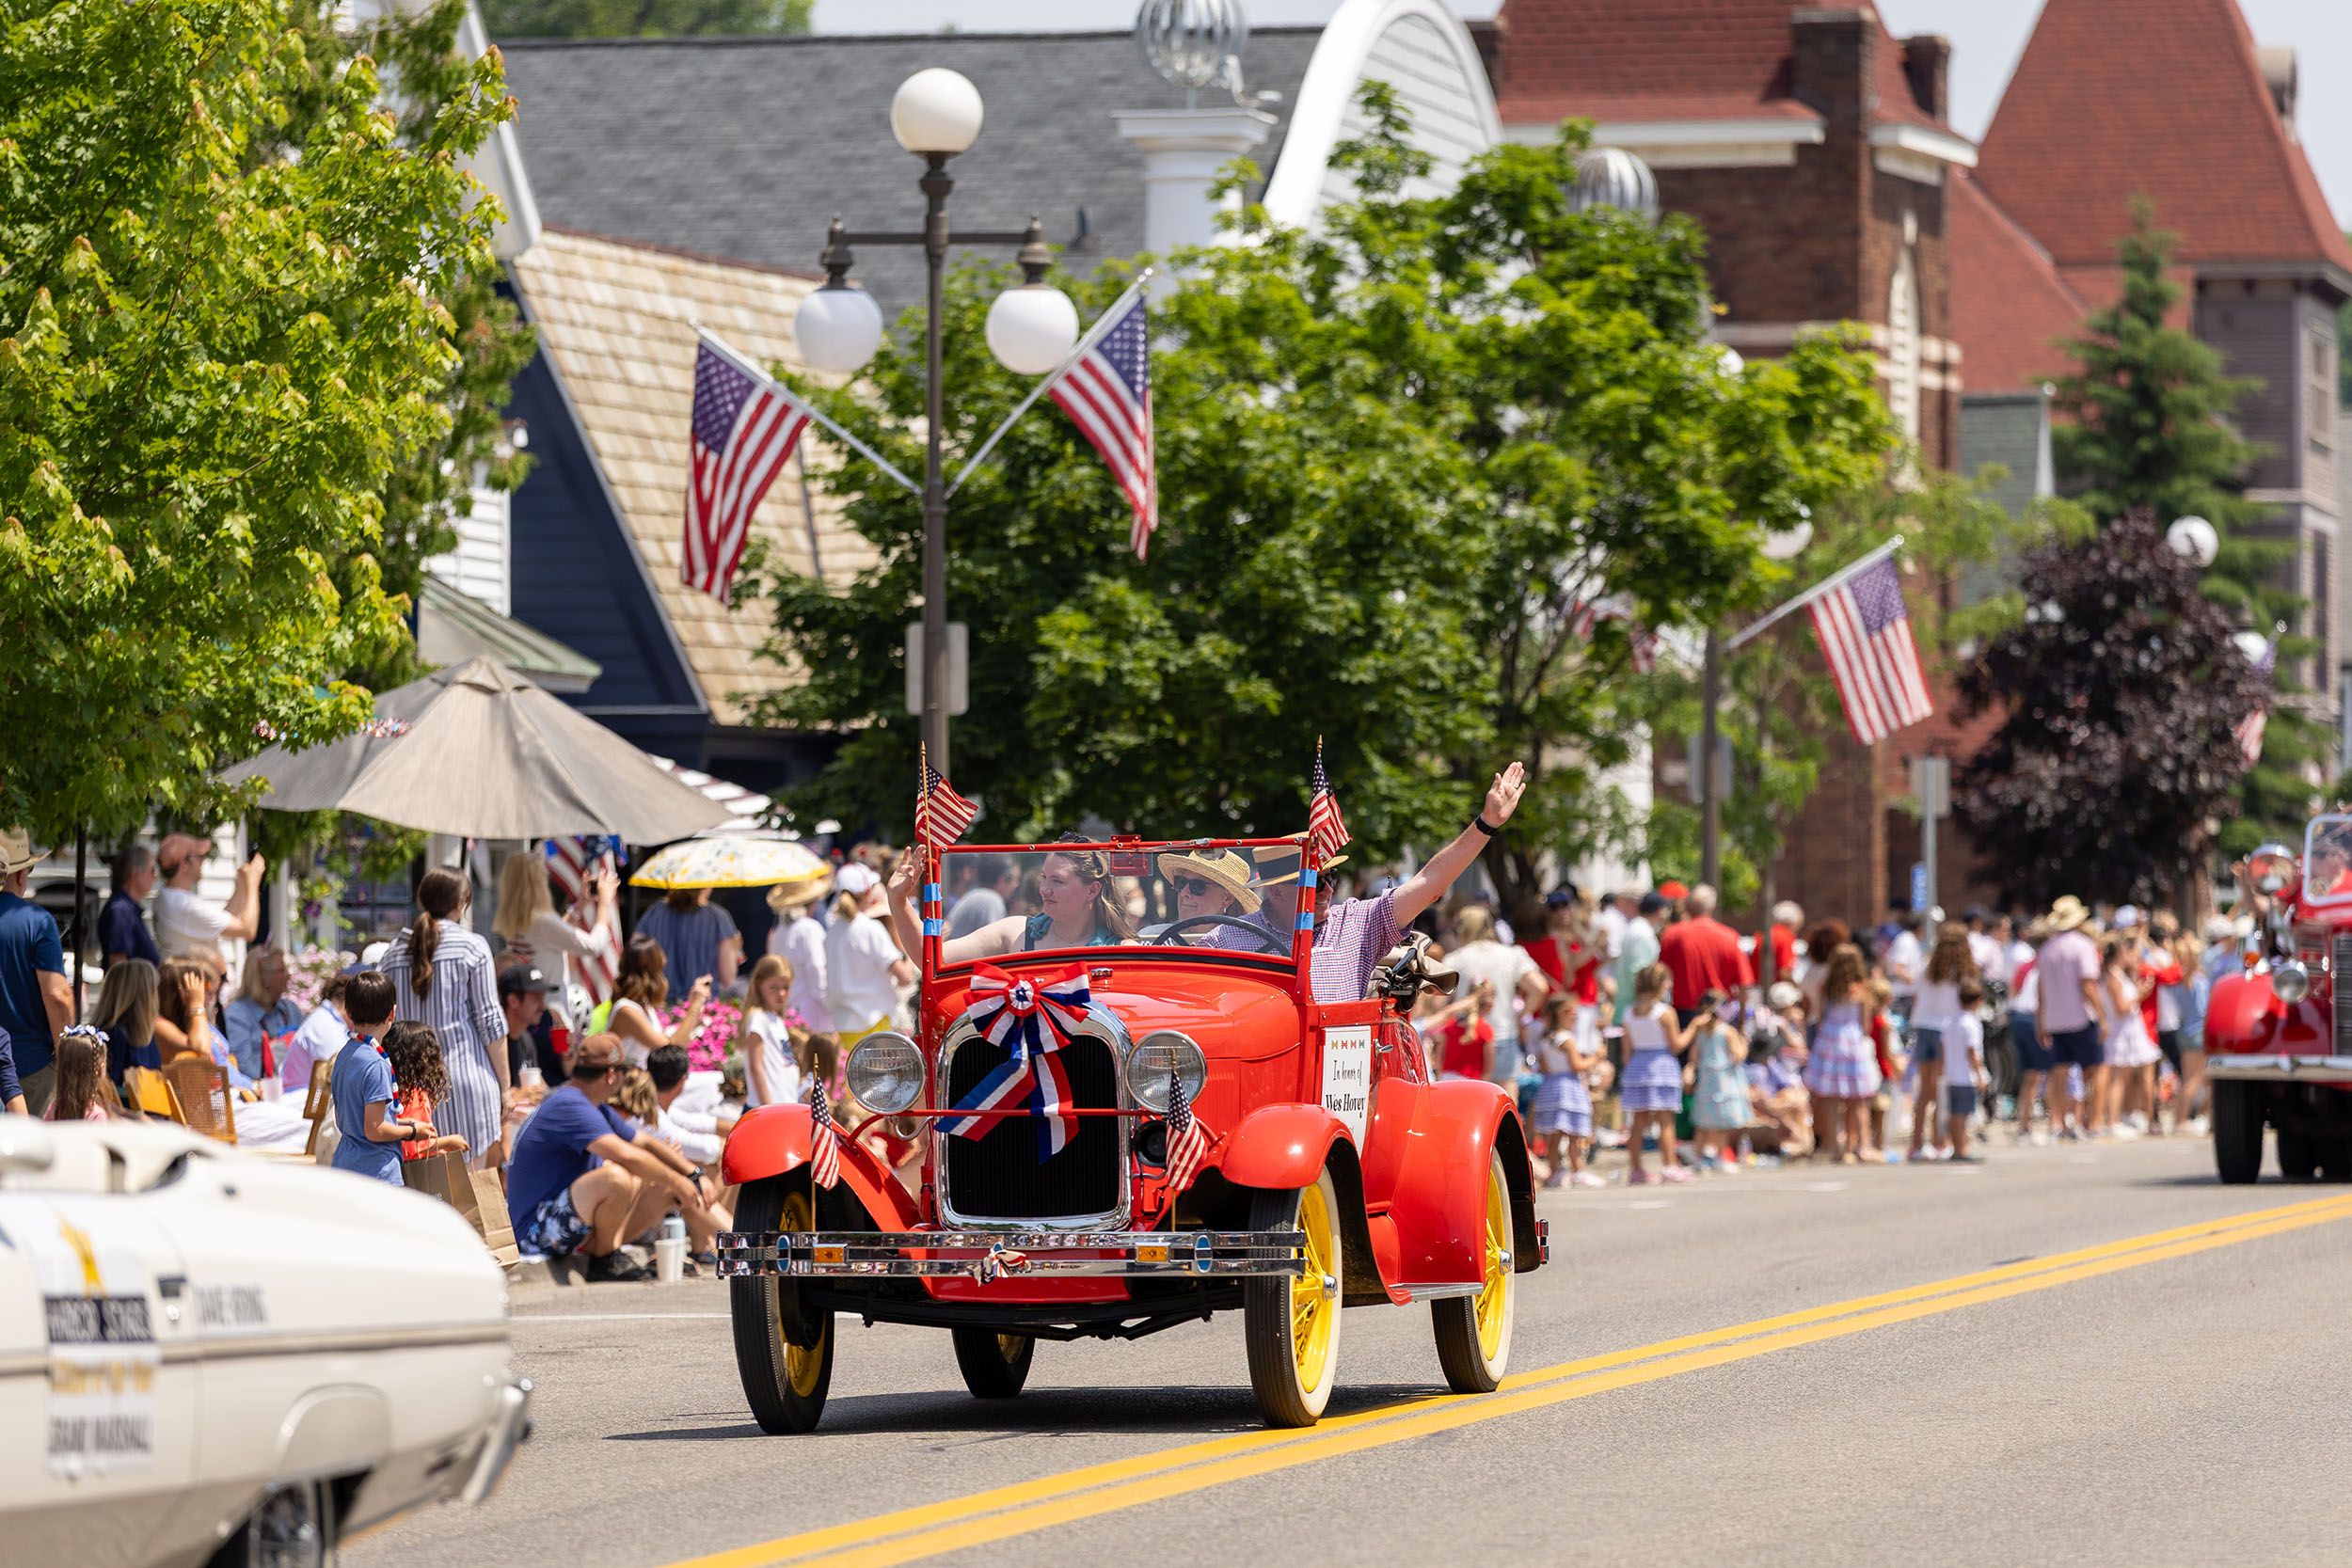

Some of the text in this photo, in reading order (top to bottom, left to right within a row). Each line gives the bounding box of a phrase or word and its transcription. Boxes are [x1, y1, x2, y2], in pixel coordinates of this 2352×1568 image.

[1332, 1059, 1363, 1087] In honor of
[1325, 1094, 1343, 1112] Wes
